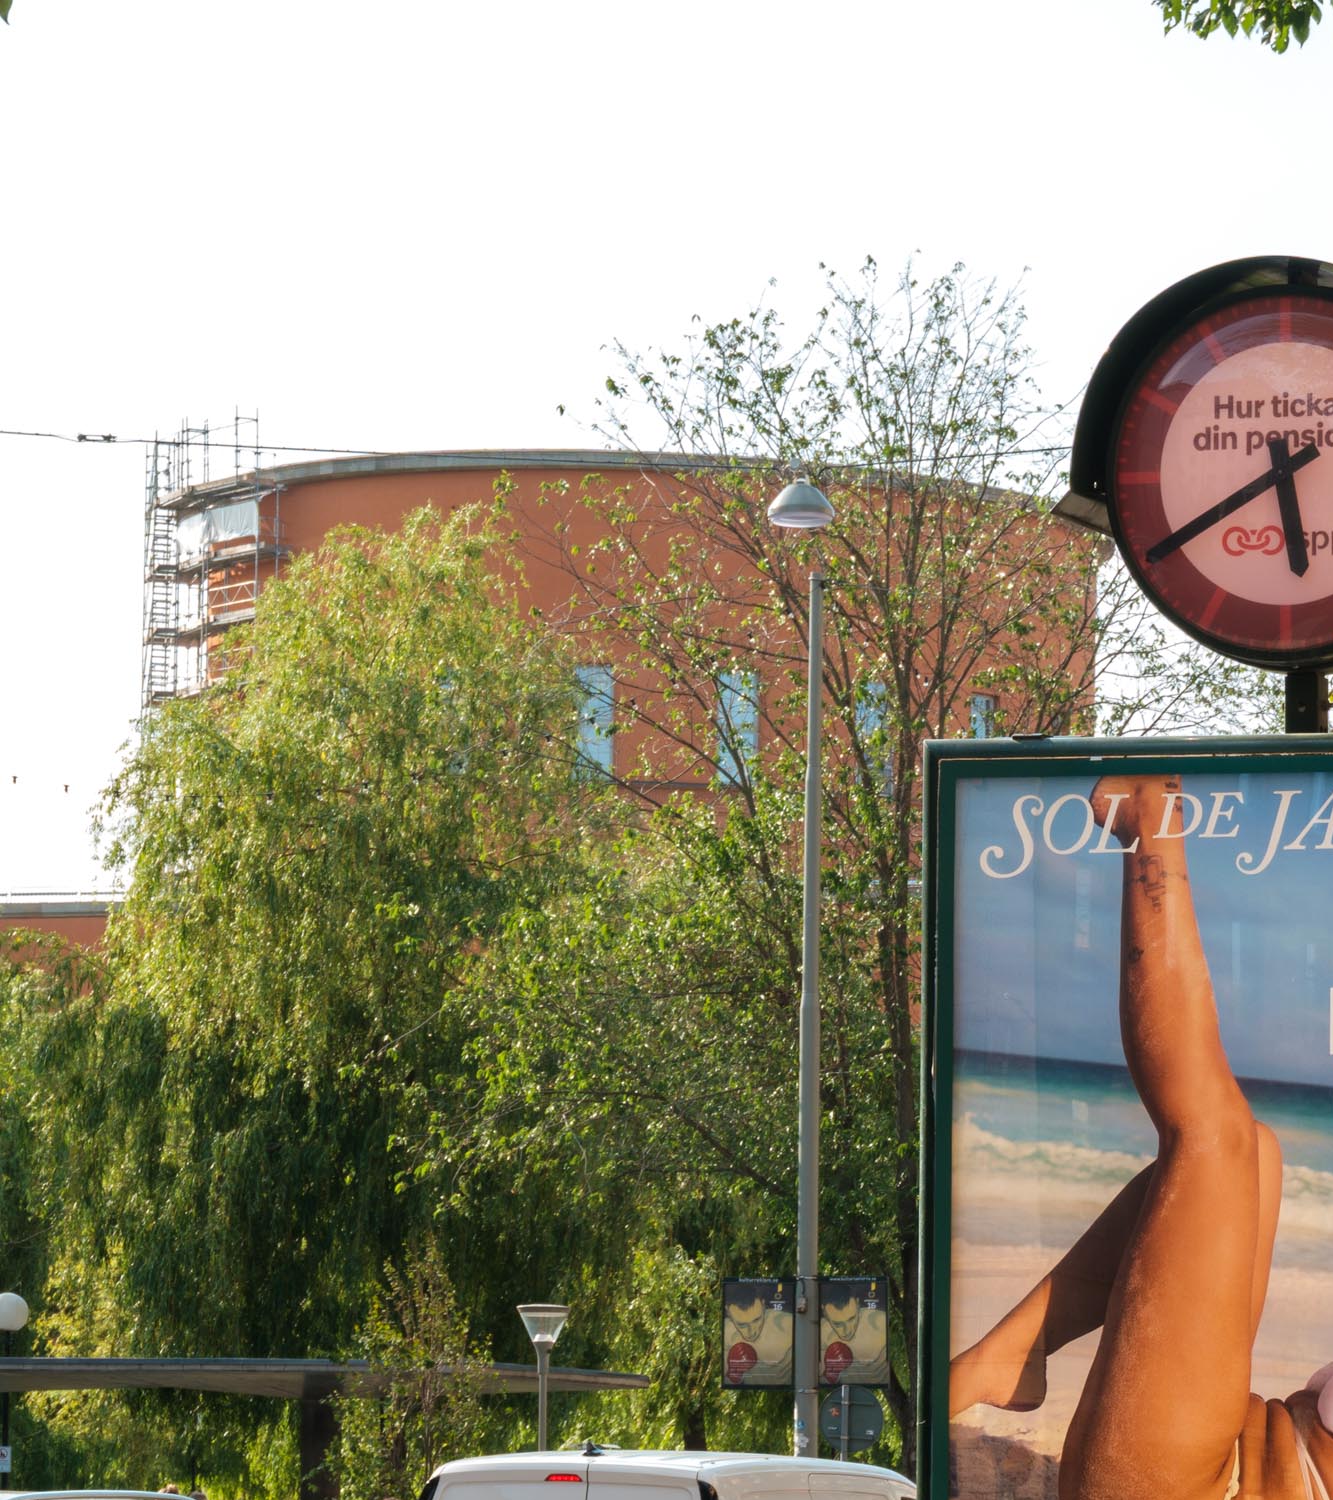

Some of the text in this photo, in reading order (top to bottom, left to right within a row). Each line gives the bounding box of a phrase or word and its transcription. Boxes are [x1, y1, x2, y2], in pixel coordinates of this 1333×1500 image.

[1213, 395, 1265, 419] Hur
[1193, 425, 1238, 451] din
[980, 790, 1140, 878] SOL
[1153, 791, 1244, 839] DE
